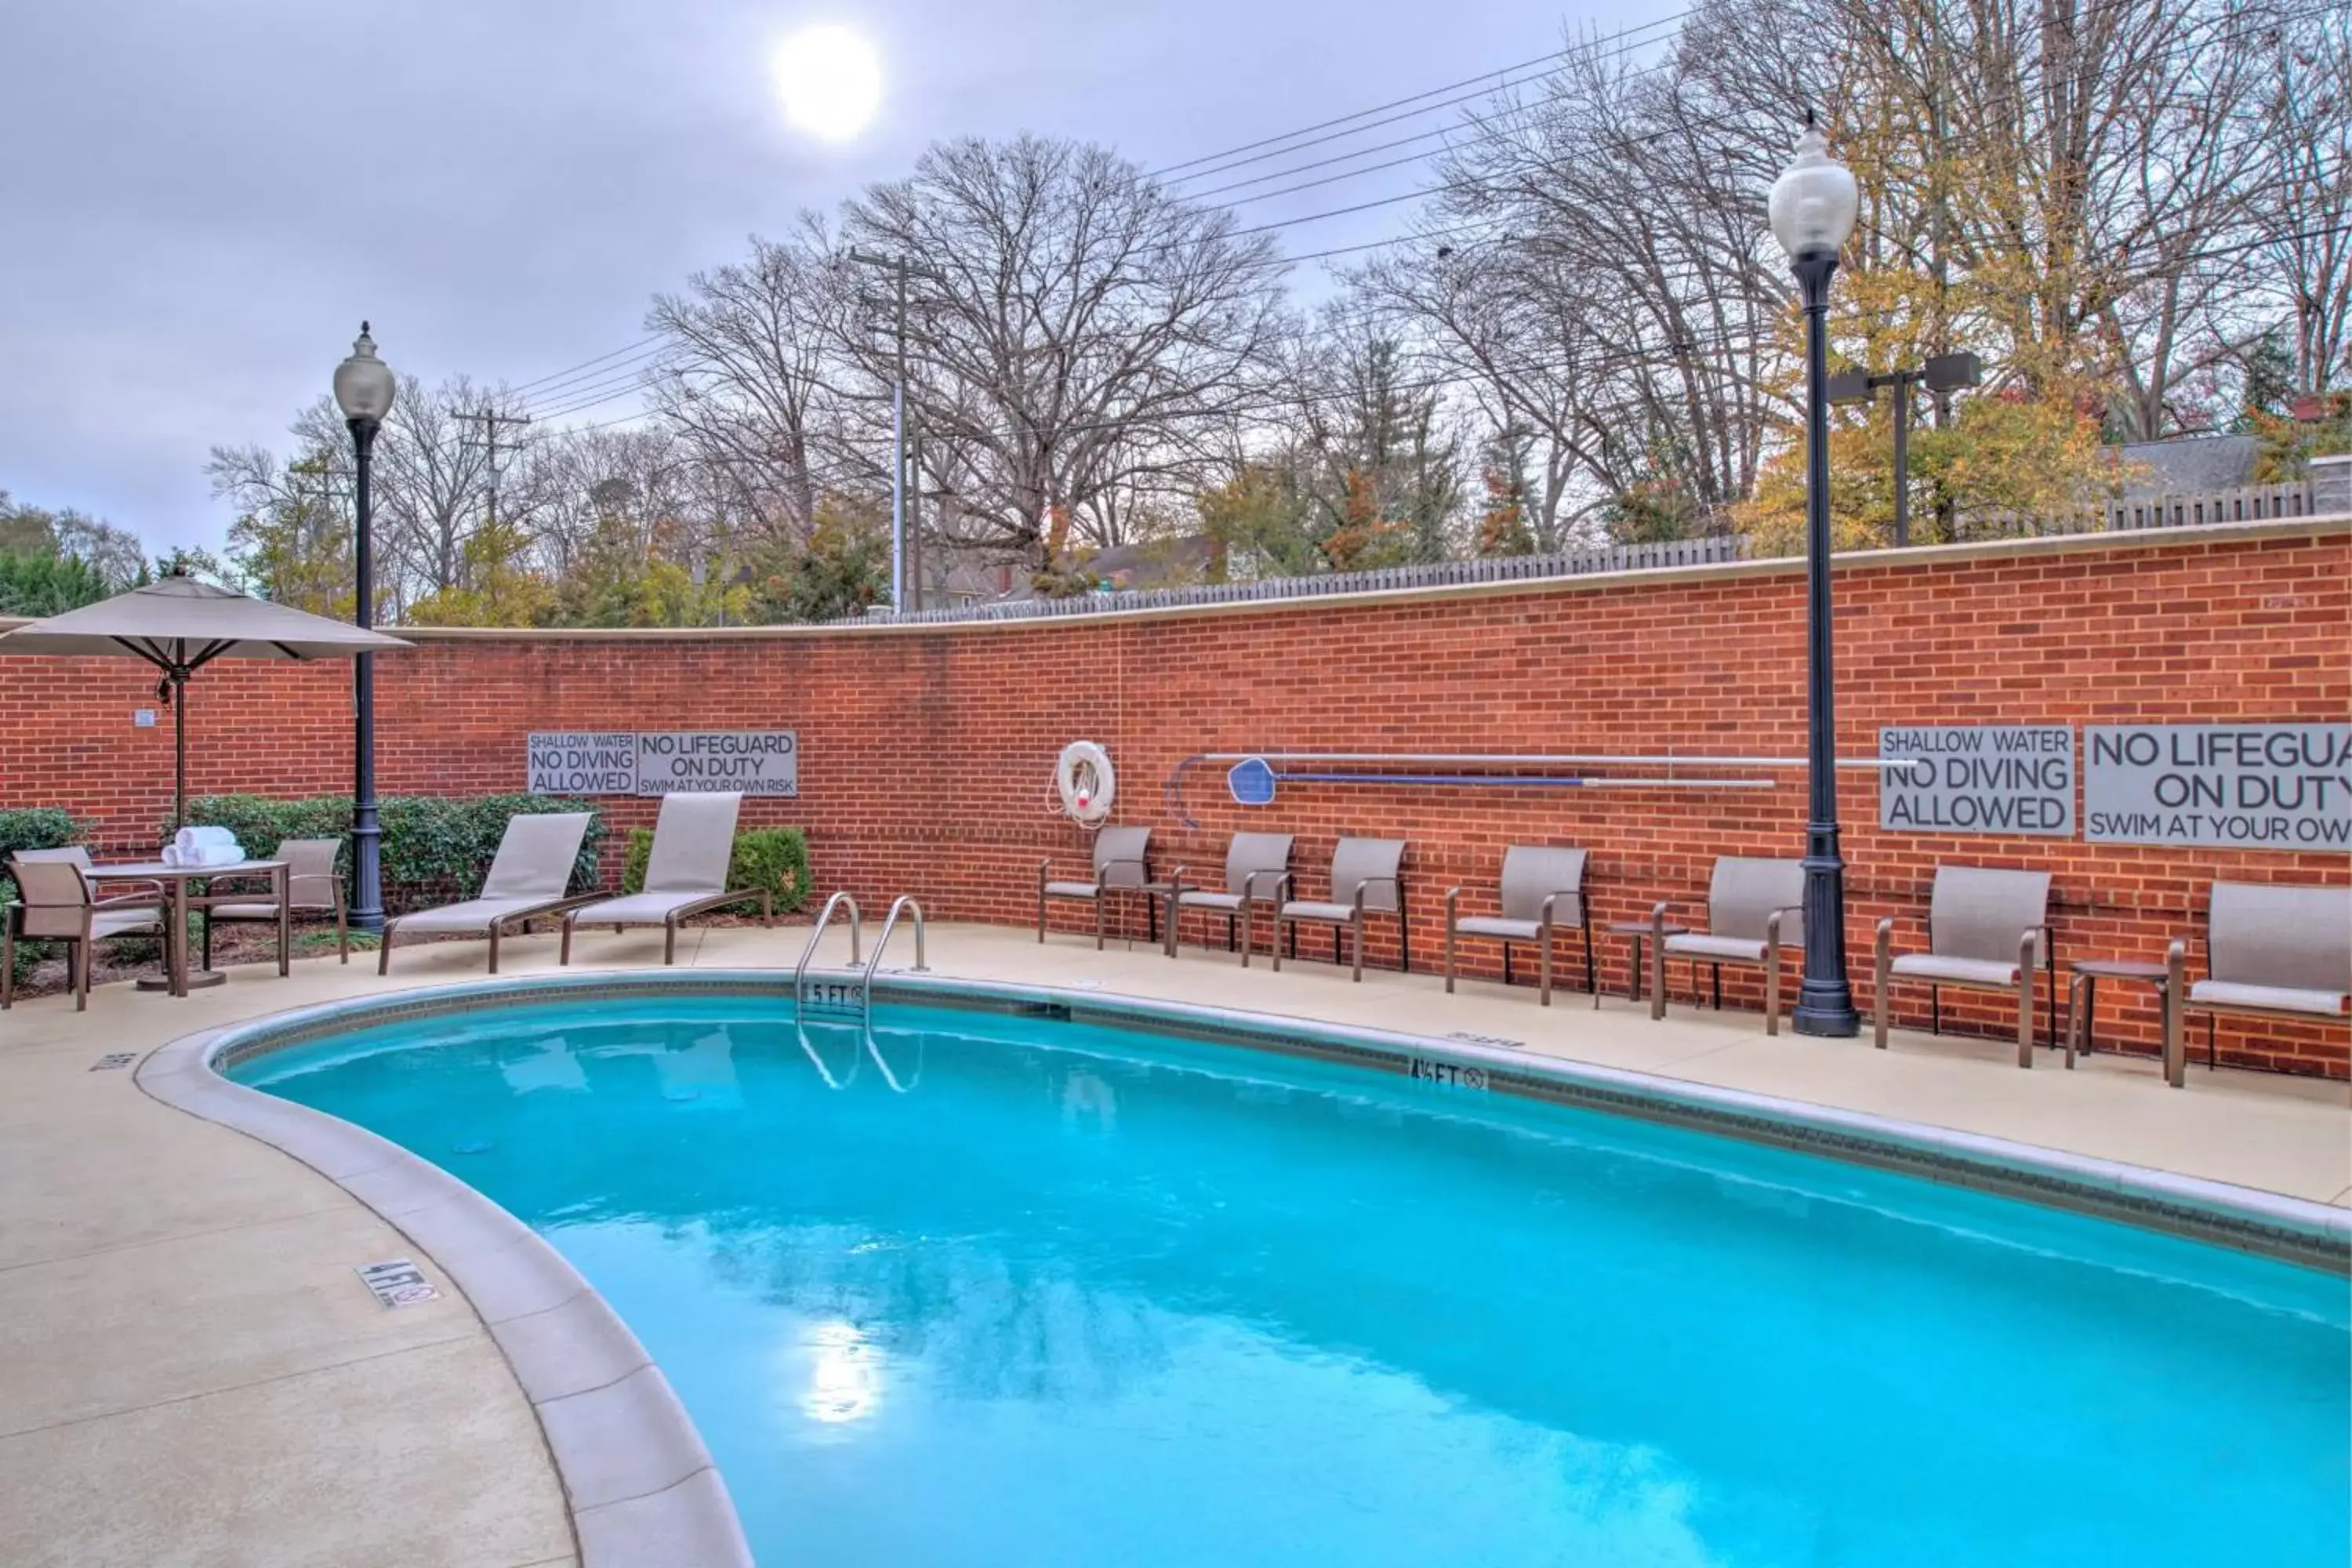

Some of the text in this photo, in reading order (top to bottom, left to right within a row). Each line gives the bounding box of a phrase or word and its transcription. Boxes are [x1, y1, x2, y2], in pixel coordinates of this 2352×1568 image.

[531, 735, 633, 748] SHALLOW WATER
[641, 735, 793, 754] NO LIFEGUARD
[1884, 730, 2068, 753] SHALLOW WATER
[2093, 732, 2159, 767] NO
[532, 750, 633, 769] NO DIVING
[671, 757, 764, 776] ON DUTY
[532, 771, 631, 791] ALLOWED
[1886, 757, 2067, 790] NO DIVING
[641, 779, 793, 792] SWIM AT YOUR OWN RISK
[2154, 773, 2223, 808] ON
[1889, 794, 2066, 829] ALLOWED
[2089, 812, 2161, 837] SWIM
[2167, 814, 2203, 838] AT
[2209, 815, 2290, 841] YOUR
[829, 985, 847, 1005] FT
[1436, 1062, 1460, 1086] FT
